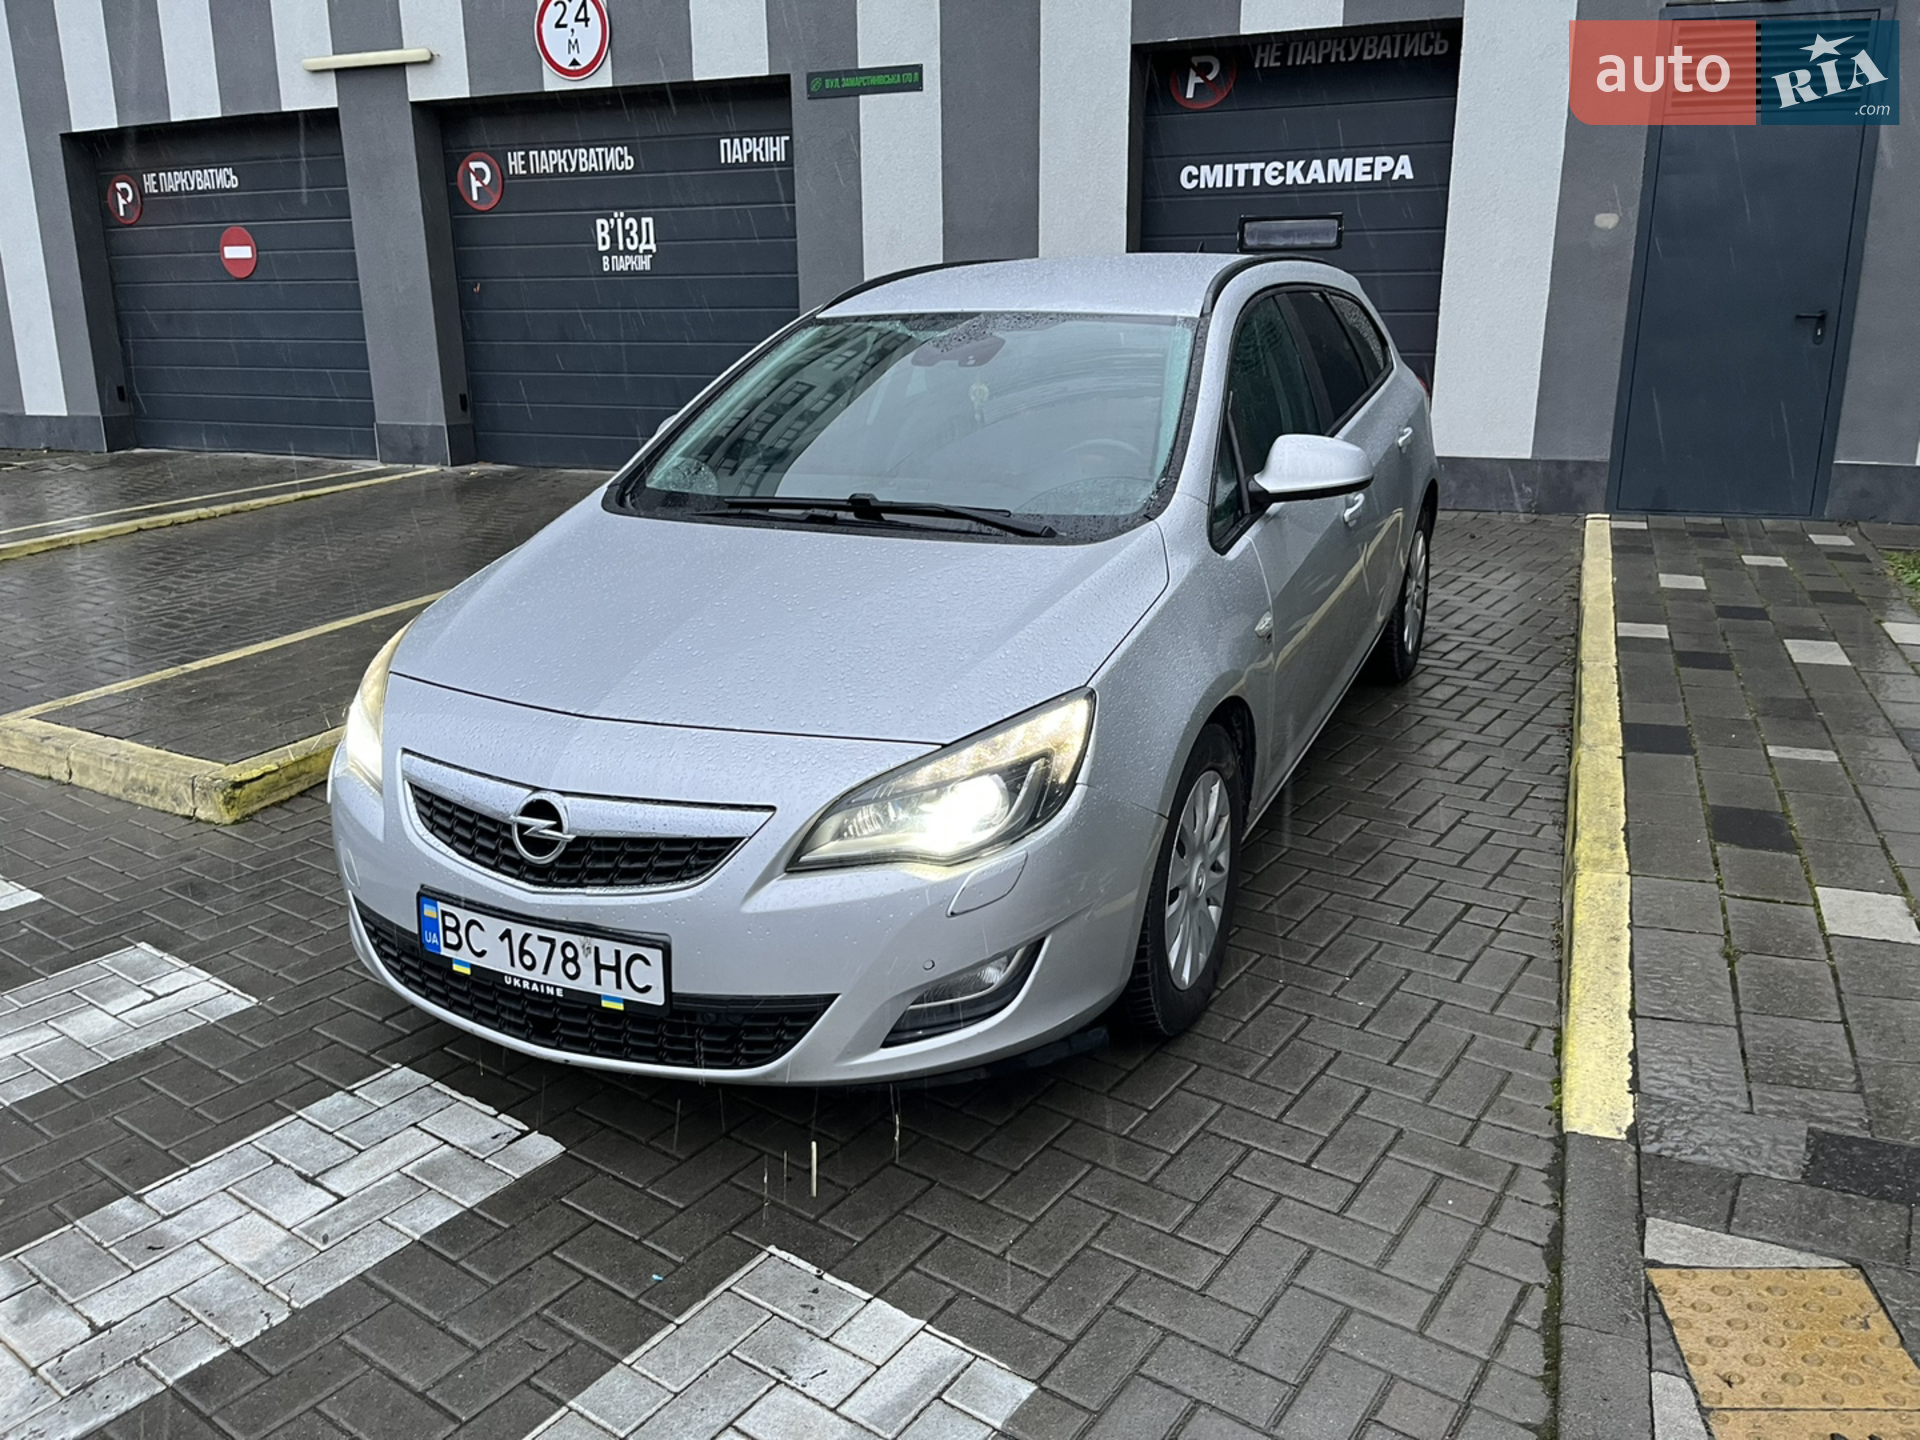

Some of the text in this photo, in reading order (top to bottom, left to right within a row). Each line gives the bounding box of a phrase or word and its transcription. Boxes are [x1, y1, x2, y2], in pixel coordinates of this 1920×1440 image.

[553, 0, 591, 36] 2,4
[1254, 31, 1449, 69] НЕ ПАРКУВАТИСЬ
[507, 146, 635, 175] НЕ ПАРКУВАТИСЬ
[719, 135, 790, 164] ПАРКІНГ
[142, 168, 239, 194] НЕ ПАРКУВАТИСЬ
[1179, 154, 1414, 190] СМІТТЄКАМЕРА
[595, 212, 657, 254] В'ЇЗД
[602, 254, 653, 272] В ПАРКІНГ
[424, 931, 439, 946] UA
[440, 909, 653, 994] BC 1678 HC
[504, 974, 564, 998] UKRAINE
